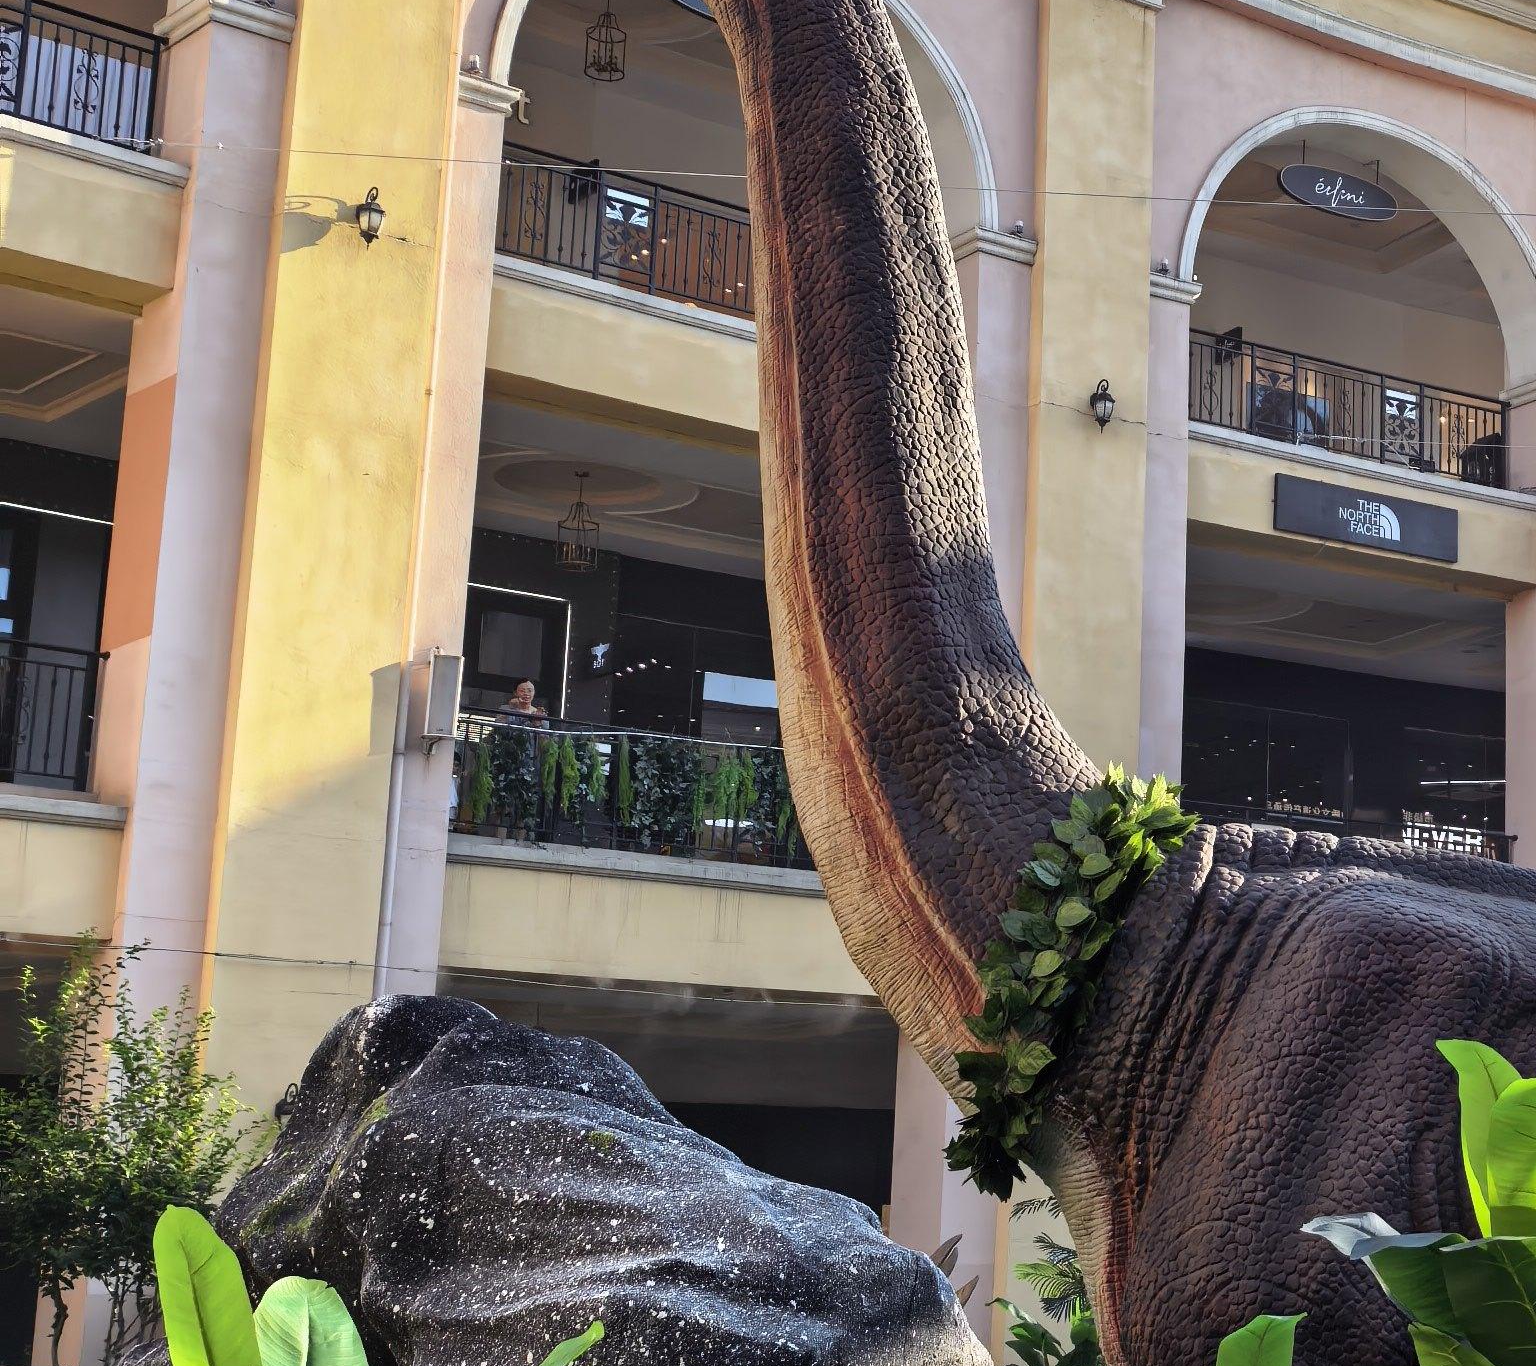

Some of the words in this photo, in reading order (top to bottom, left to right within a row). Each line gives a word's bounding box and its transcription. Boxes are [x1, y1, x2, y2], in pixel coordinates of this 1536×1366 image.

[1357, 499, 1379, 514] THE
[1339, 506, 1379, 525] NORTH
[1350, 521, 1380, 537] FACE
